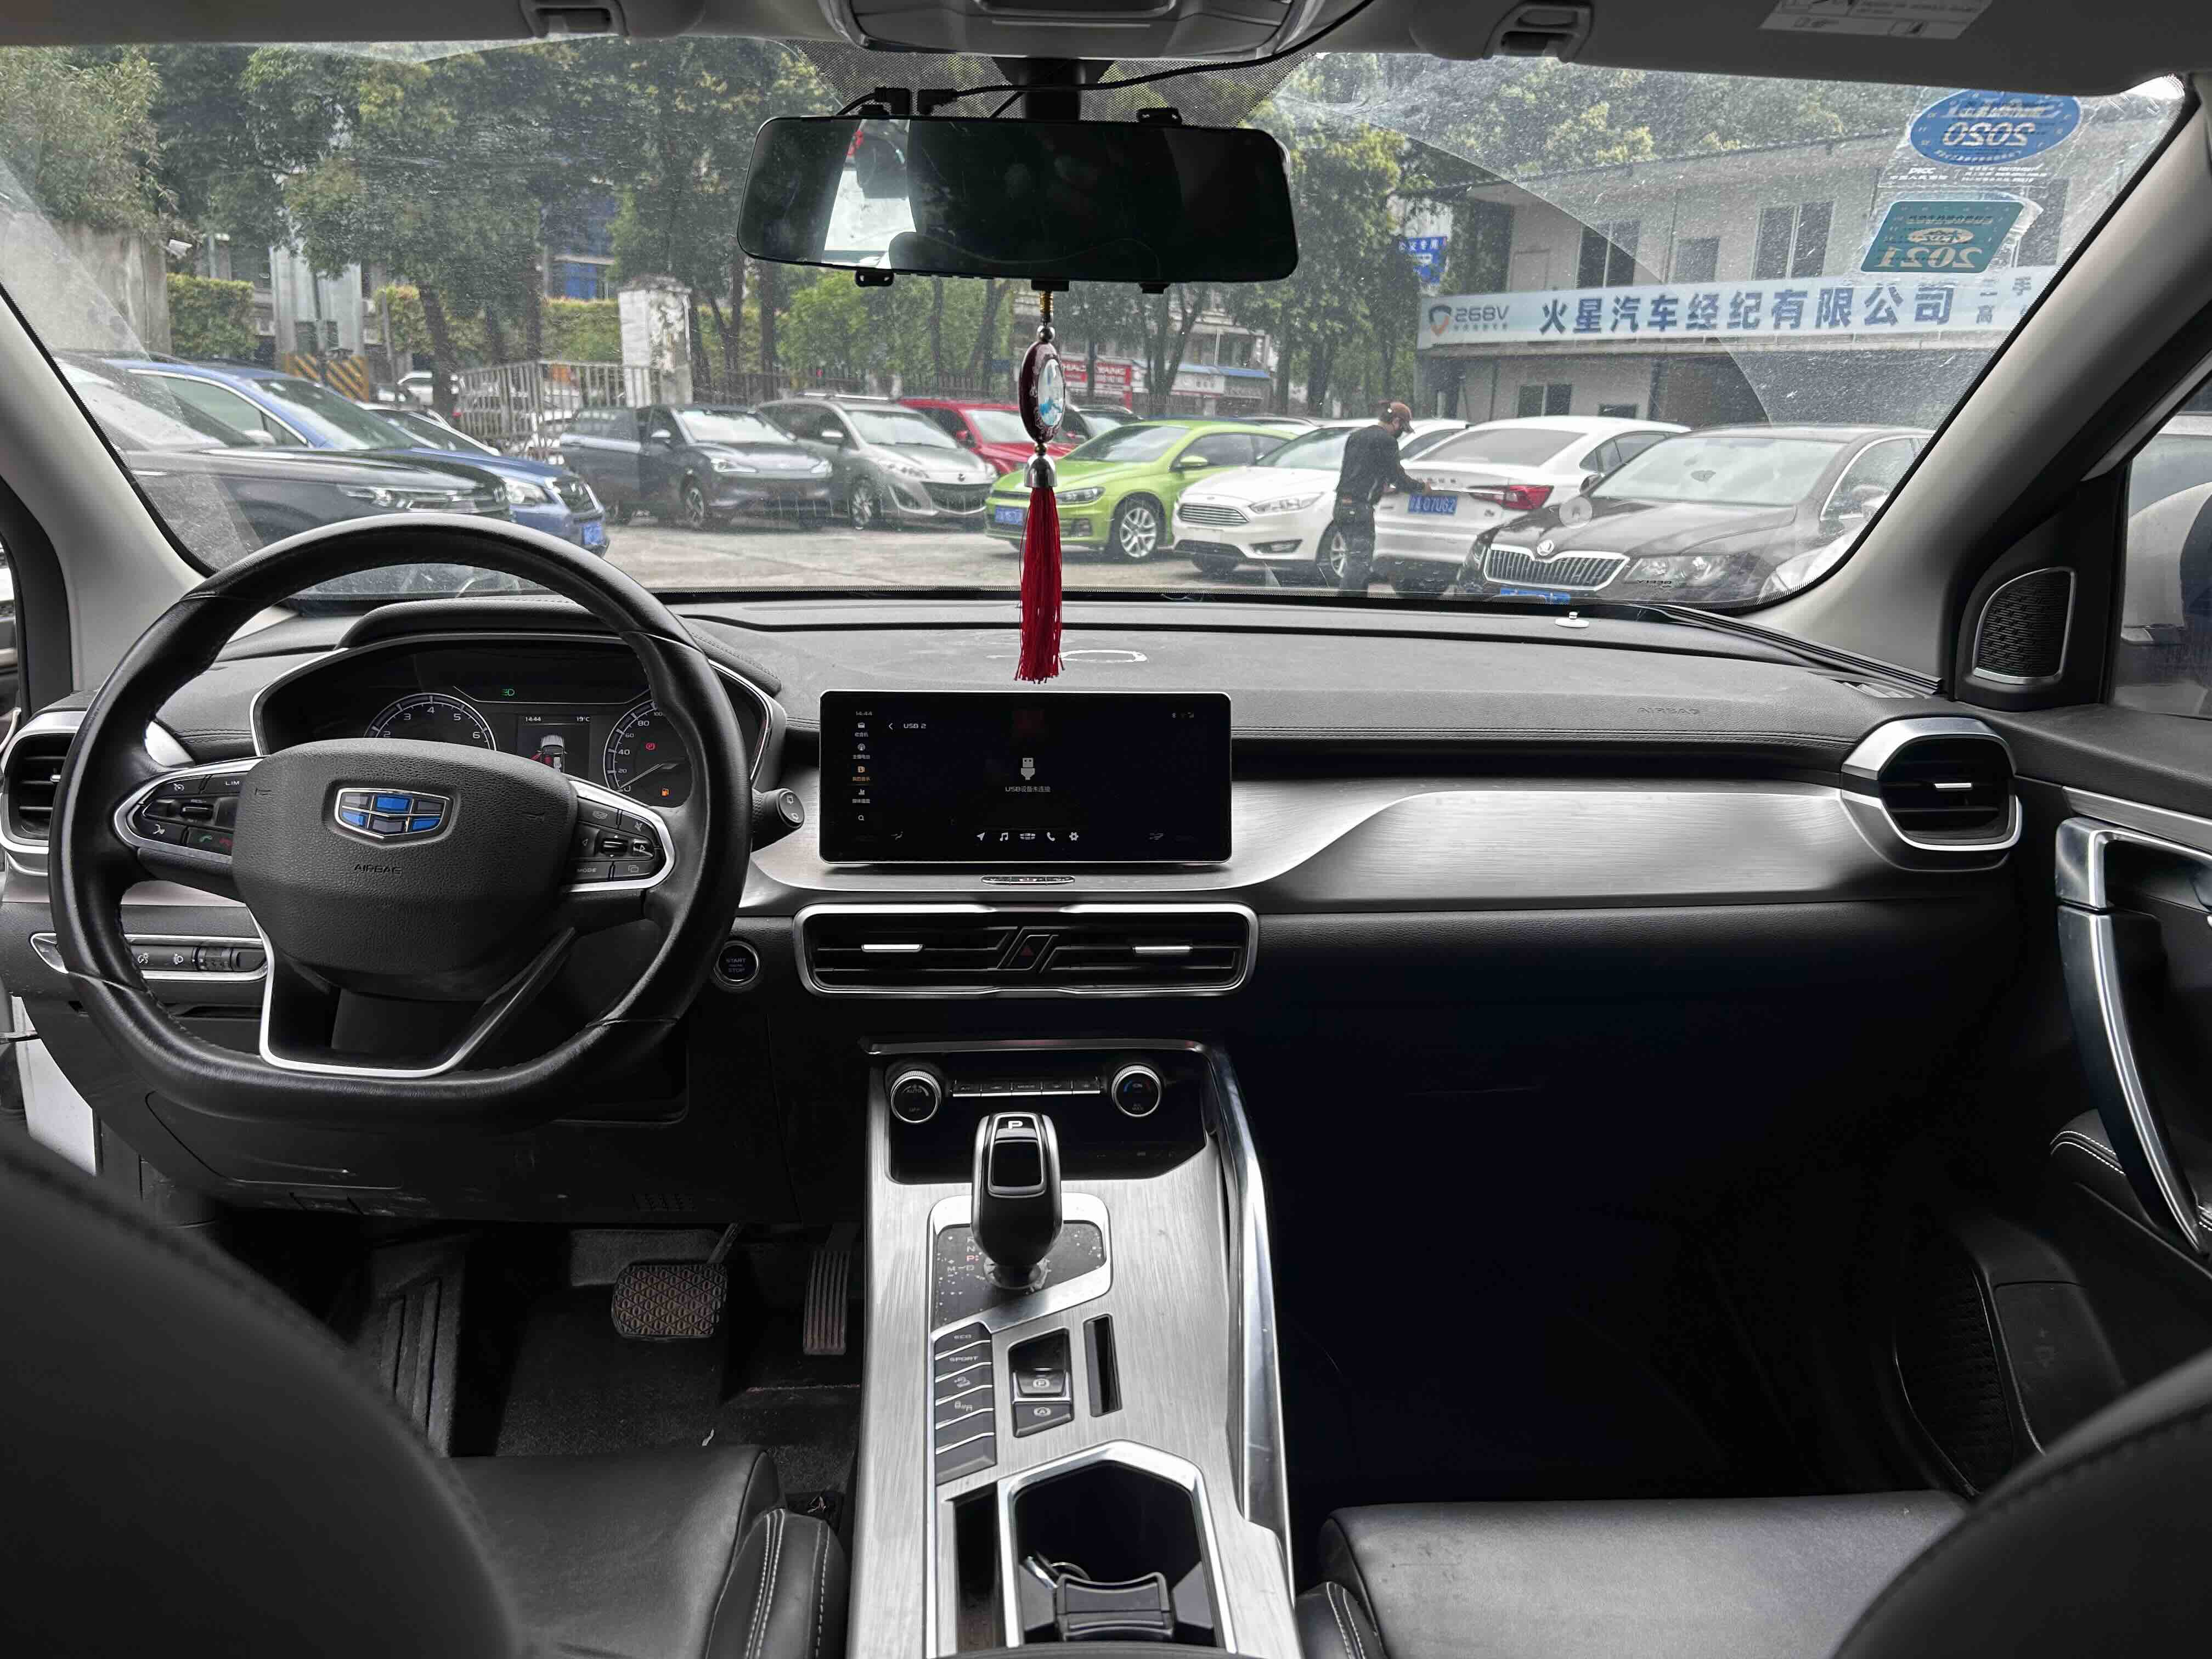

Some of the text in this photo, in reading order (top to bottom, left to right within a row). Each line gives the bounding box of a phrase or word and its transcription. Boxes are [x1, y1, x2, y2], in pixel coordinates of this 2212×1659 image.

[1539, 281, 1955, 334] 火星汽车经纪有限公司
[354, 864, 402, 875] AIRBAG
[1008, 1121, 1023, 1130] P
